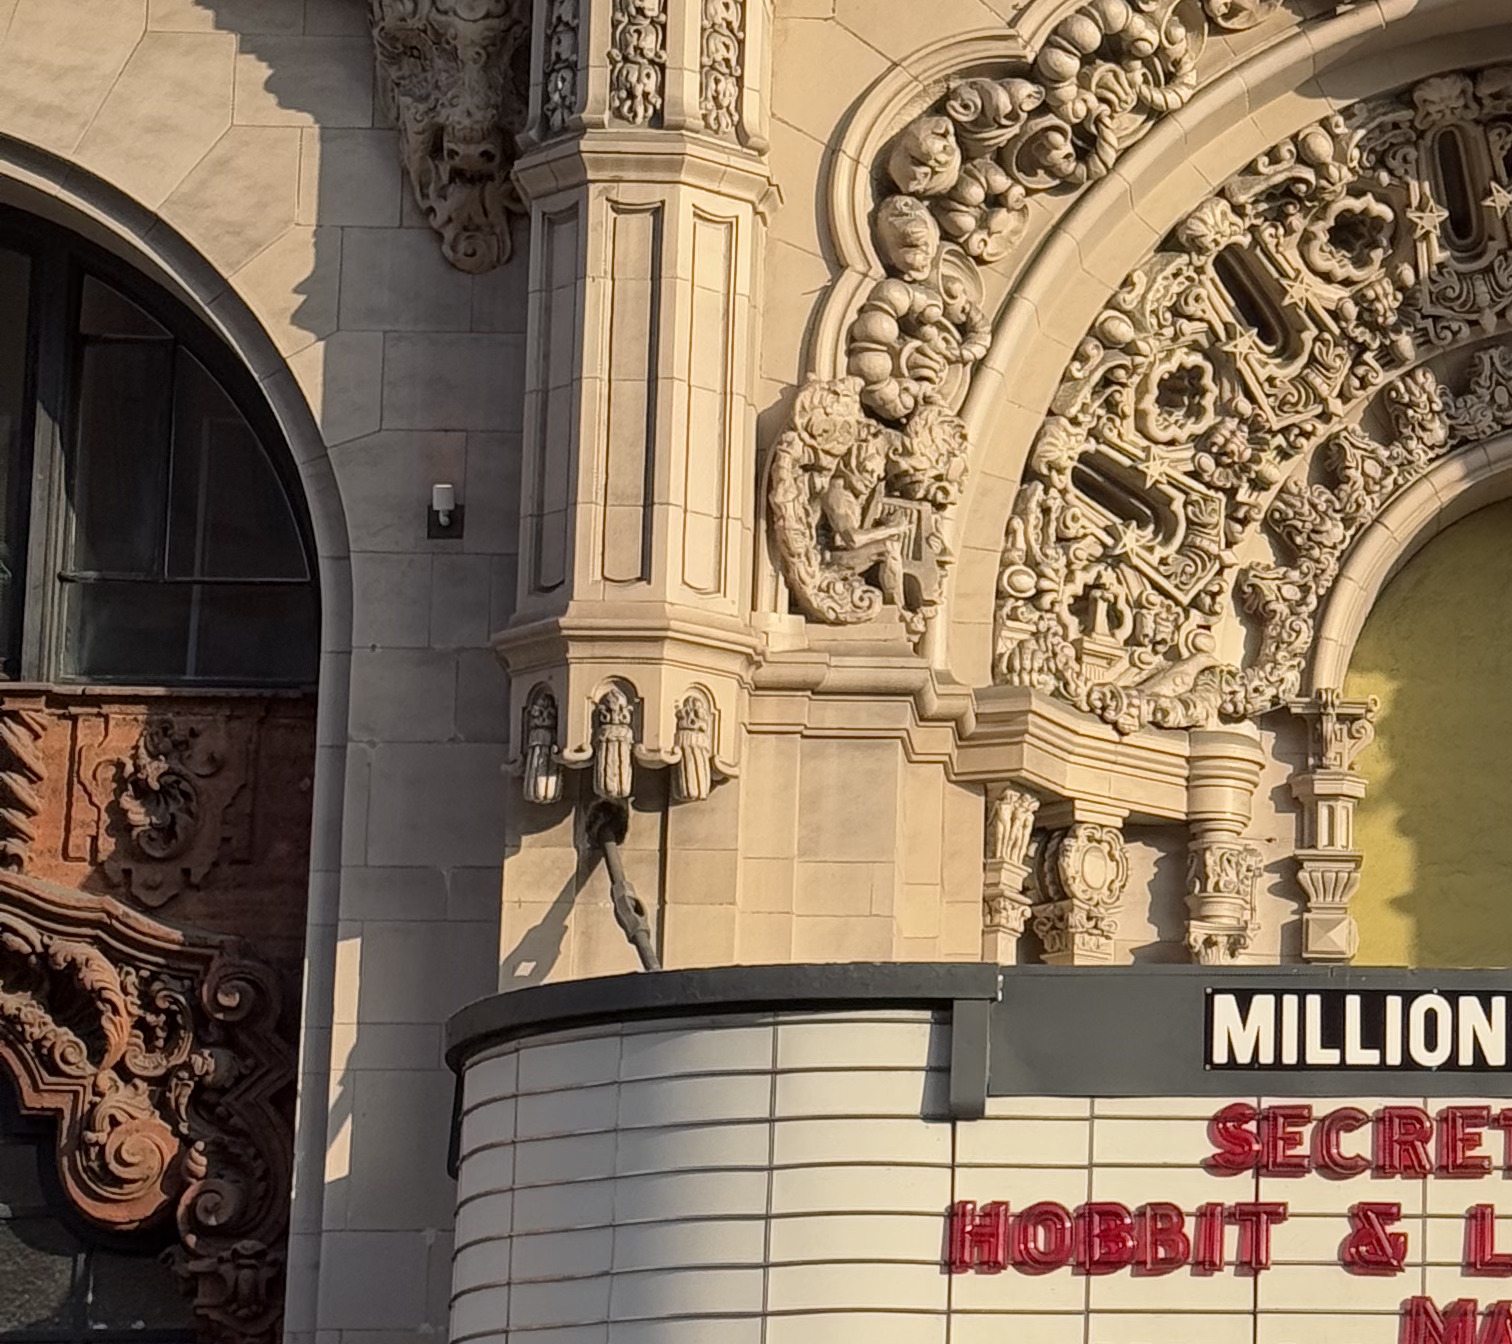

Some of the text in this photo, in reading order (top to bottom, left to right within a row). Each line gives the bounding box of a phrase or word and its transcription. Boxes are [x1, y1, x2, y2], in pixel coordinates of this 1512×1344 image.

[1211, 993, 1507, 1067] MILLION
[947, 1200, 1288, 1276] HOBBIT
[1341, 1202, 1408, 1276] &
